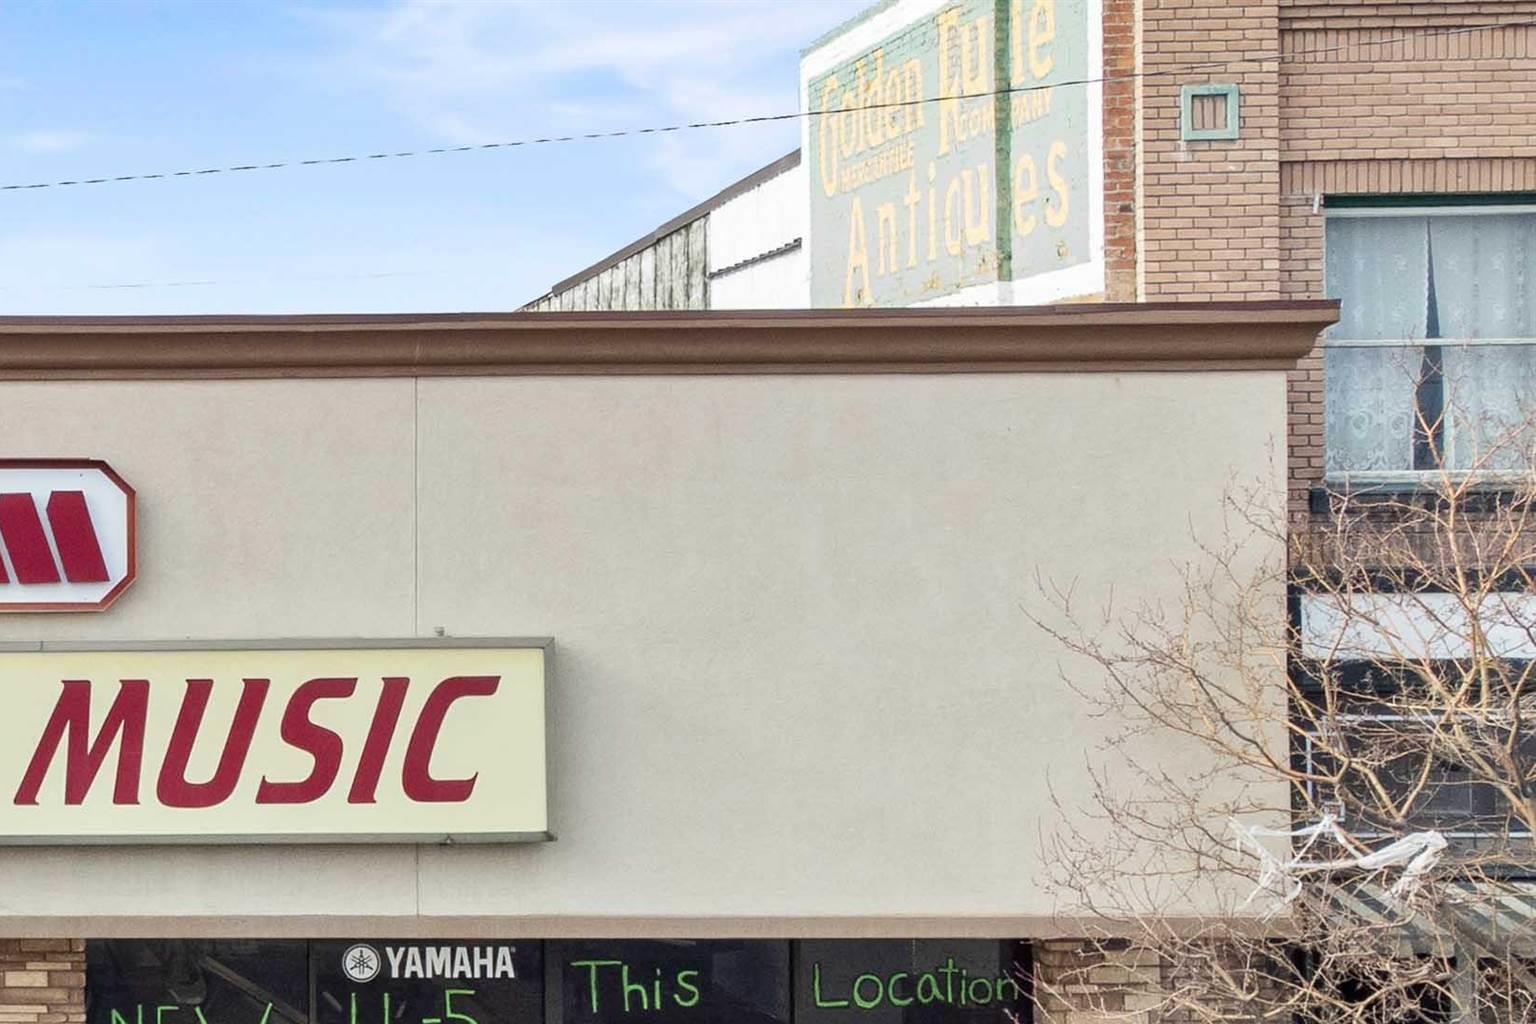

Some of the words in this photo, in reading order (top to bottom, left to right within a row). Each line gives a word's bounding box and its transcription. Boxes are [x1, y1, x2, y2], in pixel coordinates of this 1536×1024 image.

[818, 47, 925, 198] Golden
[842, 138, 1070, 309] Antiques
[13, 675, 503, 808] MUSIC
[385, 945, 516, 979] YAMAHA
[570, 959, 700, 1014] This
[814, 957, 1020, 1009] Location
